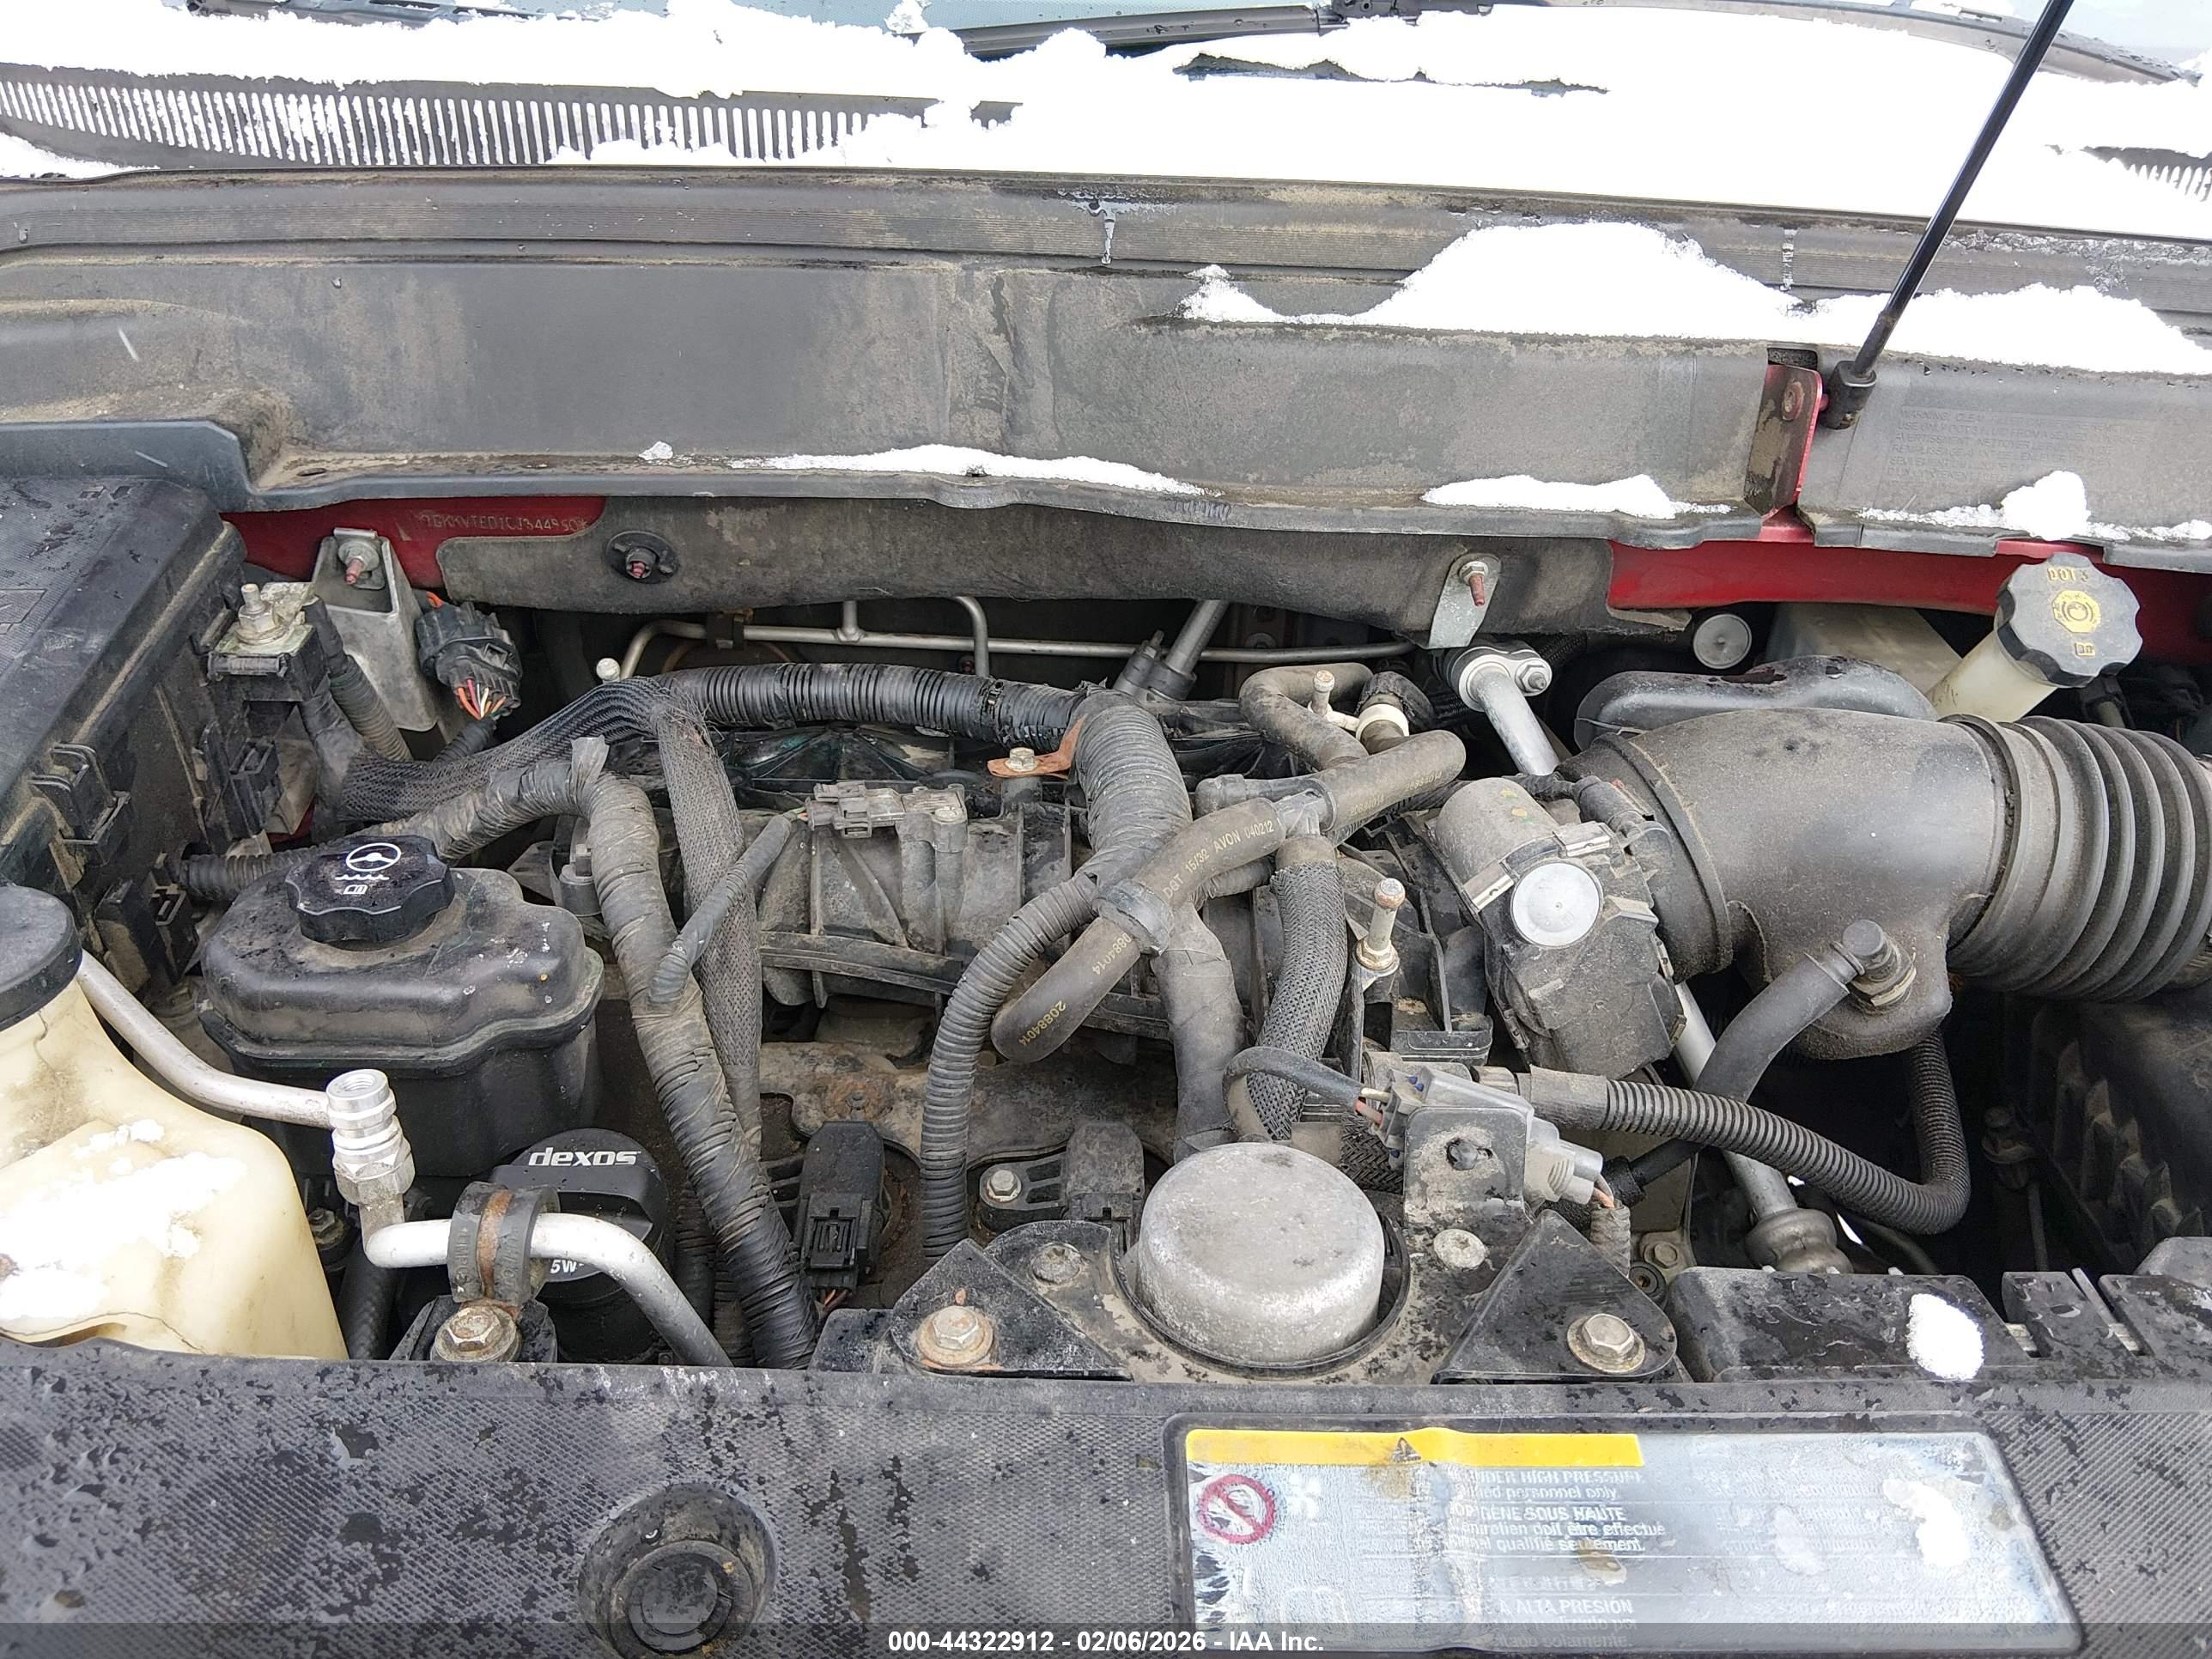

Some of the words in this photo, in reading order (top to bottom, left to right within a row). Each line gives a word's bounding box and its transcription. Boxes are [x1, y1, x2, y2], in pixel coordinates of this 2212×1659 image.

[2047, 567, 2075, 582] DOT
[1185, 848, 1210, 872] 15/32
[1212, 830, 1242, 853] AVON
[1243, 820, 1274, 839] 040212
[1018, 1000, 1066, 1046] 20884014
[529, 1147, 639, 1166] dexos
[1523, 1507, 1570, 1521] SOUS
[1559, 1596, 1634, 1615] PRESIÓN
